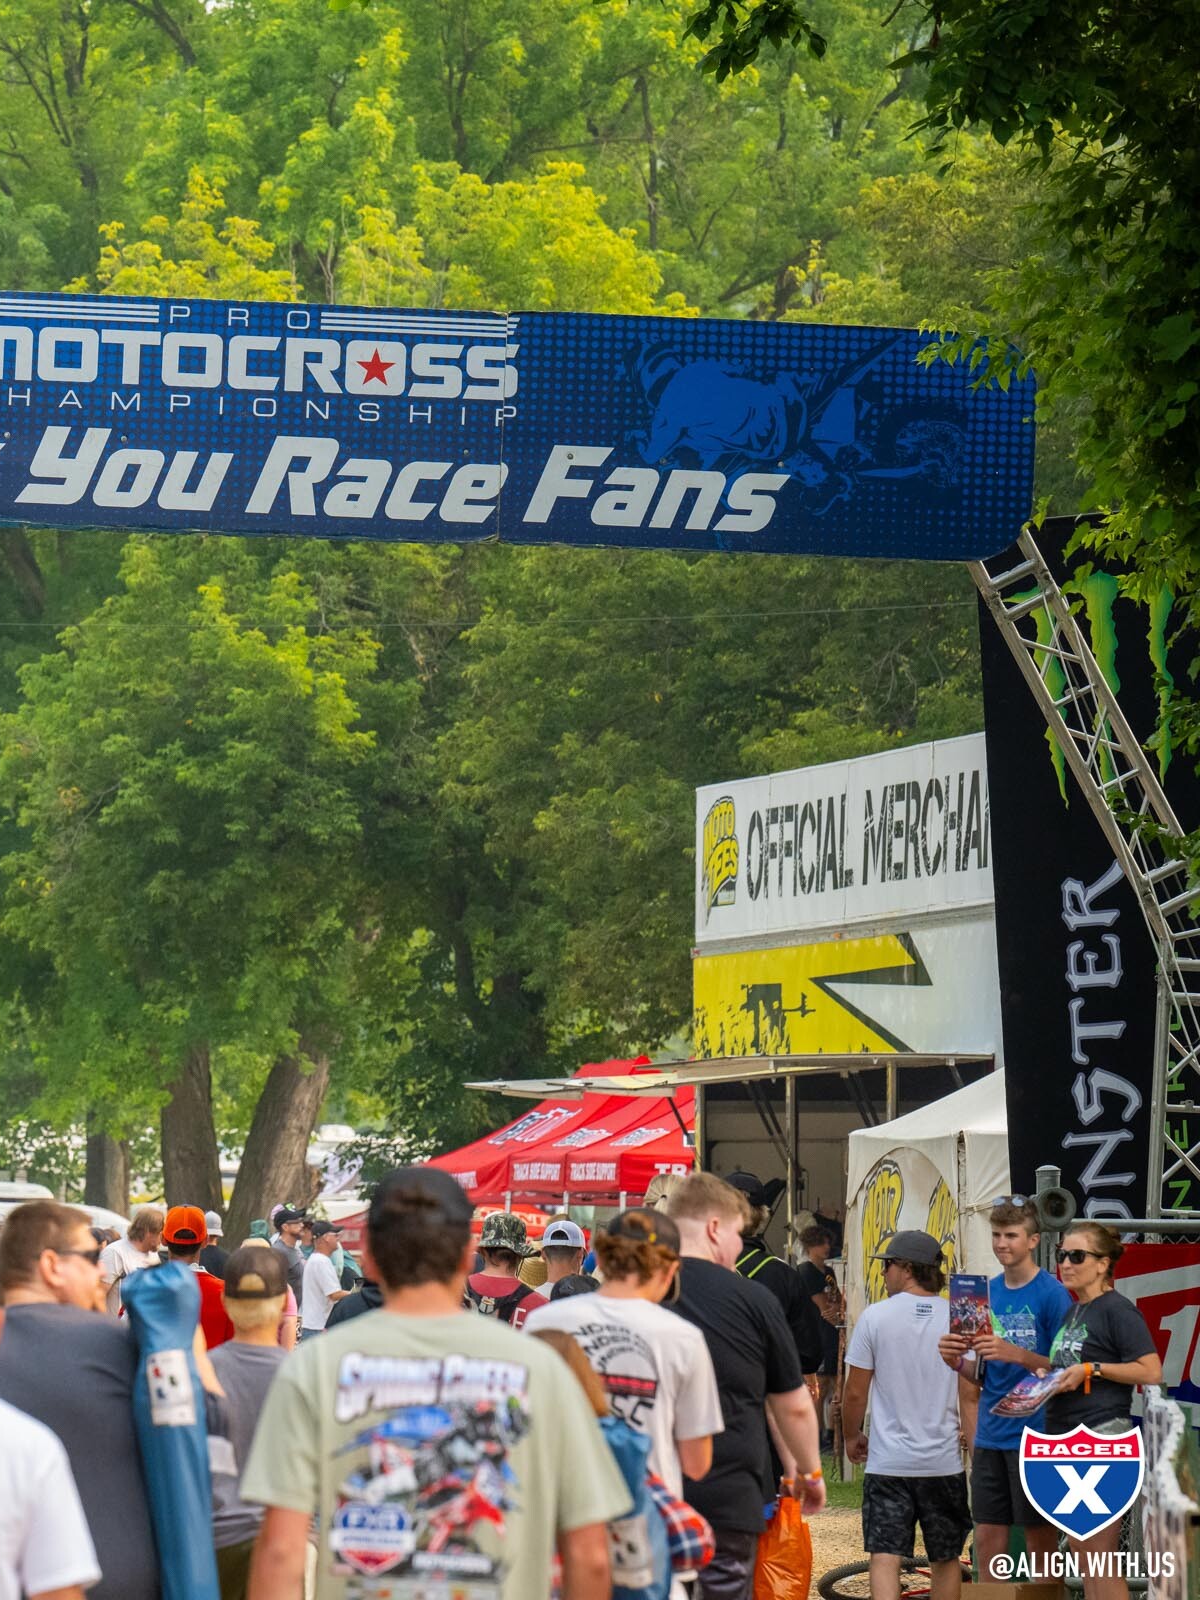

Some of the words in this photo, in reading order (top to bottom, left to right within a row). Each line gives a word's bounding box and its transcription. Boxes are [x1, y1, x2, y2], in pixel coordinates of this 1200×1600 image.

[169, 305, 310, 330] PRO
[14, 425, 233, 511] You
[246, 435, 508, 524] Race
[523, 444, 791, 533] Fans
[747, 793, 854, 901] OFFICIAL
[862, 770, 990, 886] MERCHA
[1061, 858, 1143, 1218] NSTER
